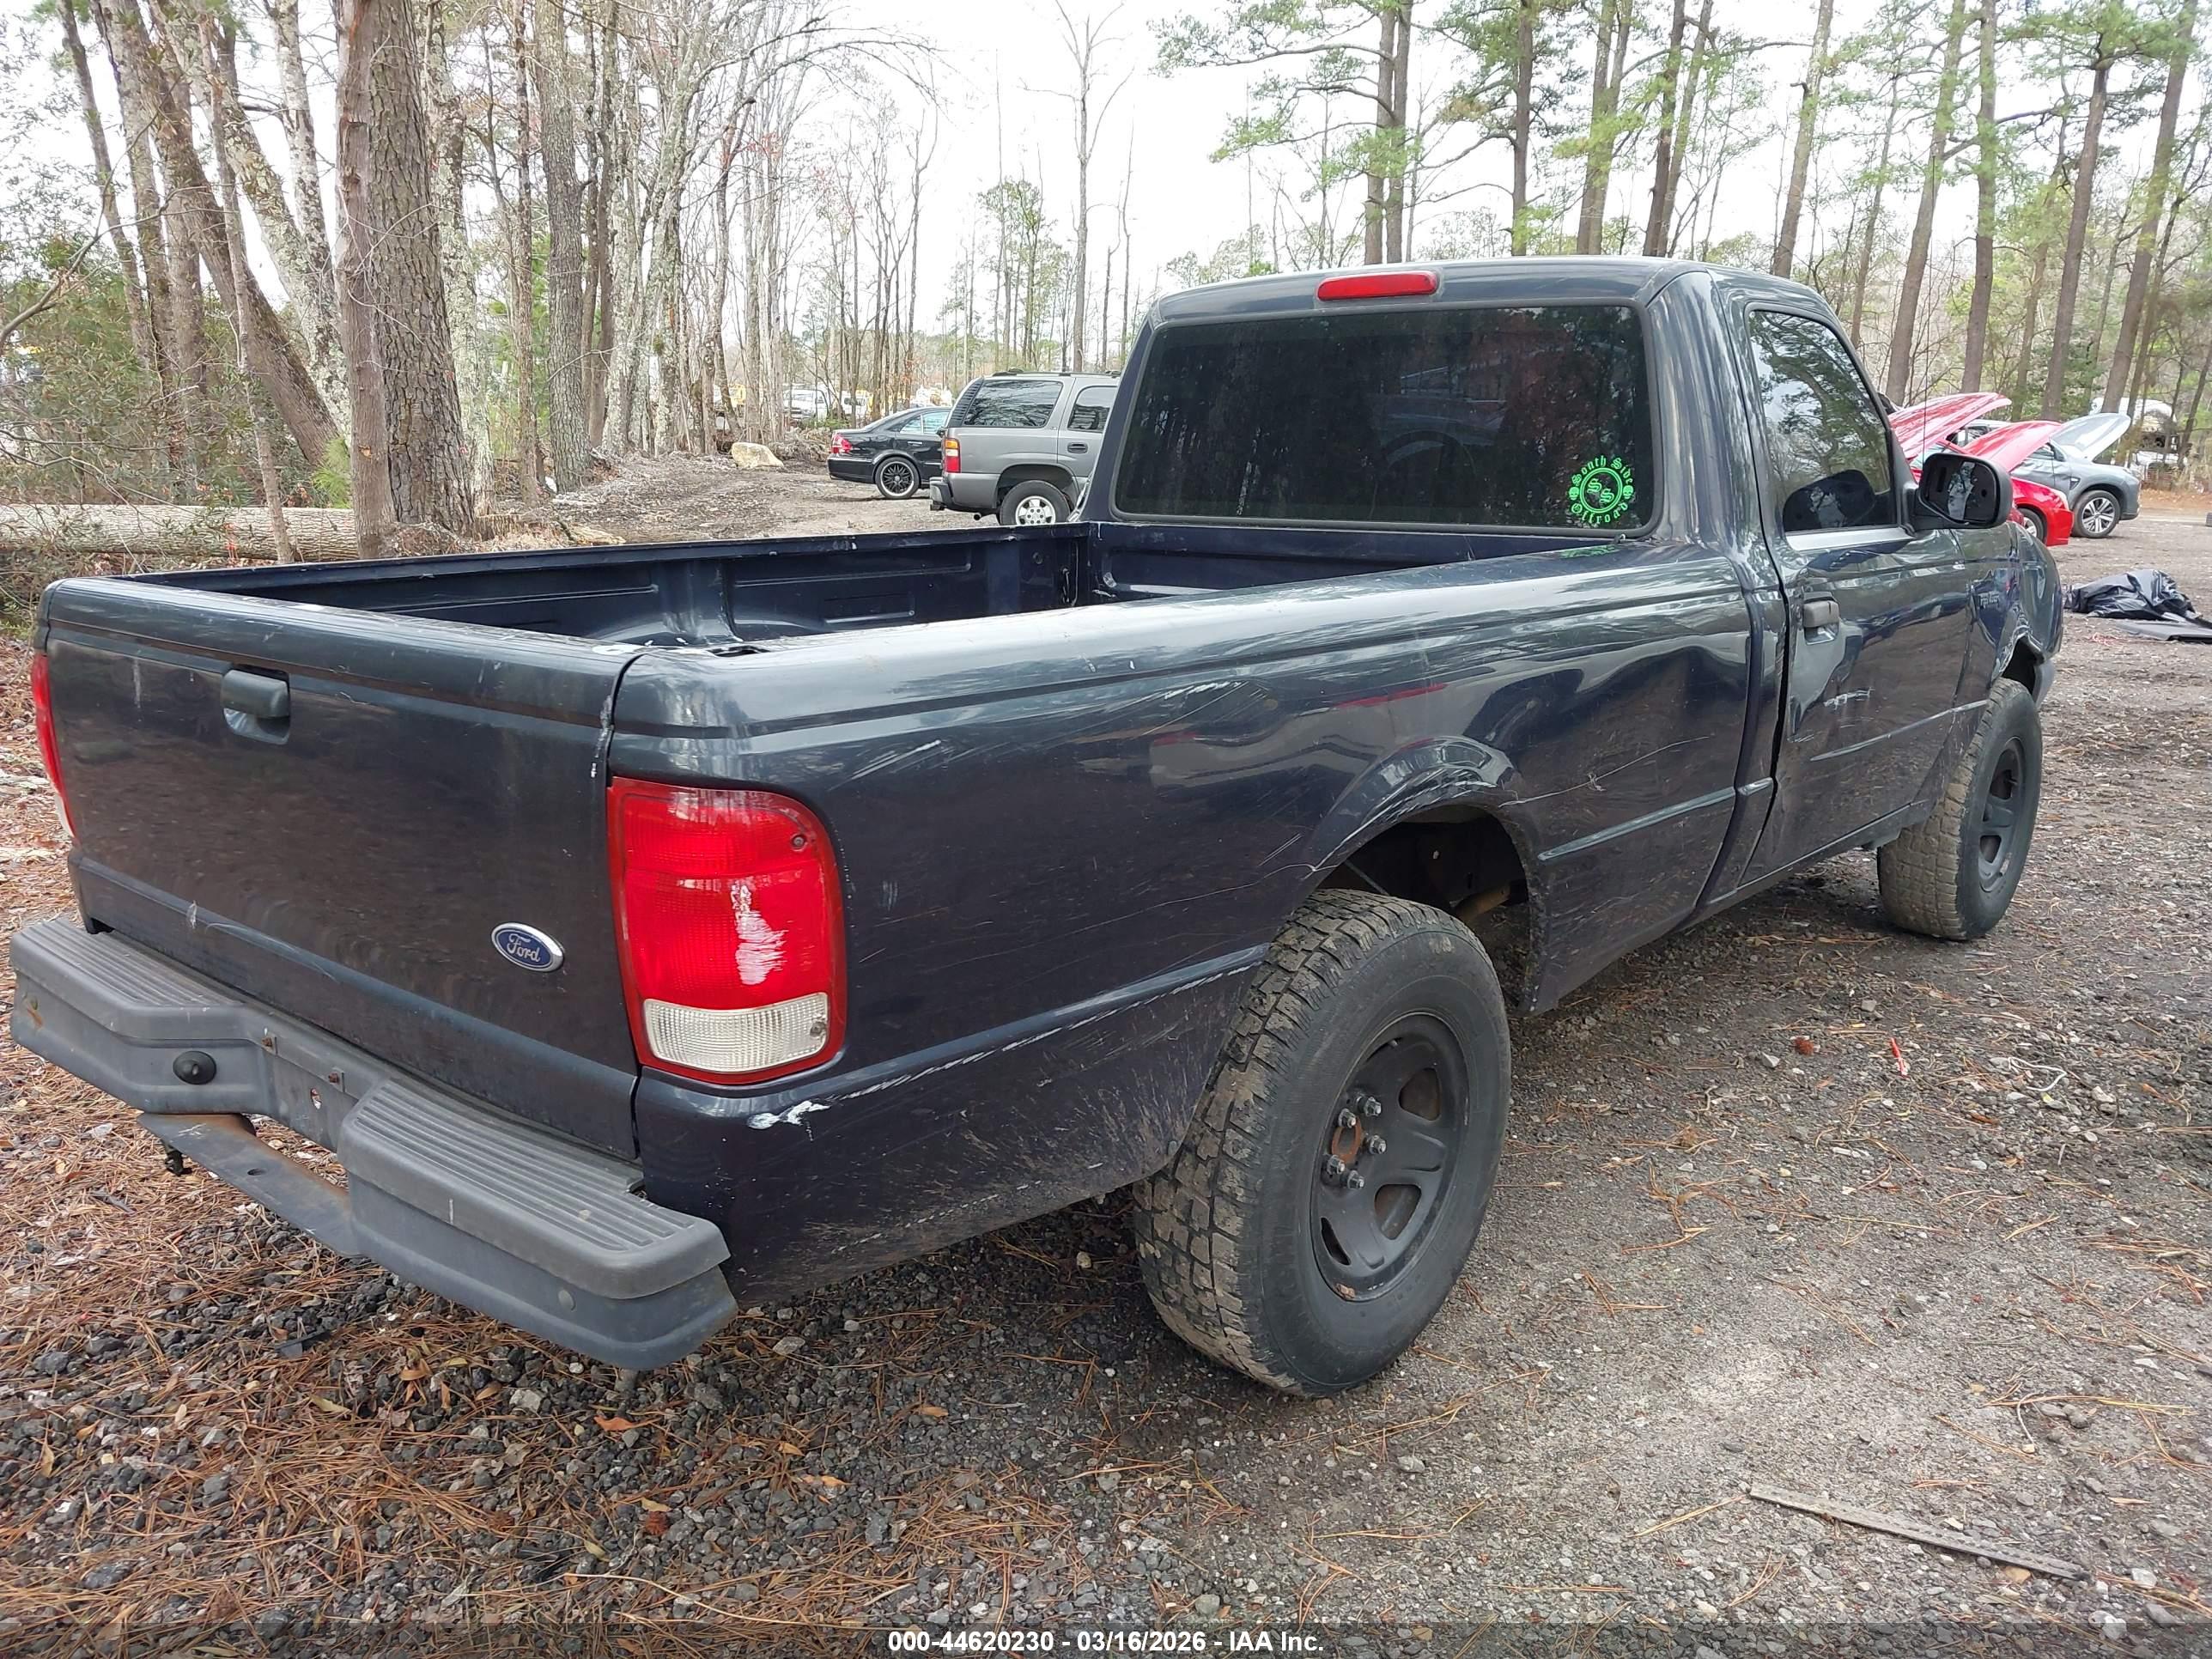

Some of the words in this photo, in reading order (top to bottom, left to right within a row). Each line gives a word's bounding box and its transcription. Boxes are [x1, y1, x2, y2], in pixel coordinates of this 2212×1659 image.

[1571, 455, 1607, 487] South
[1610, 456, 1634, 484] Side
[1571, 502, 1629, 525] Offroad
[507, 933, 541, 963] Ford
